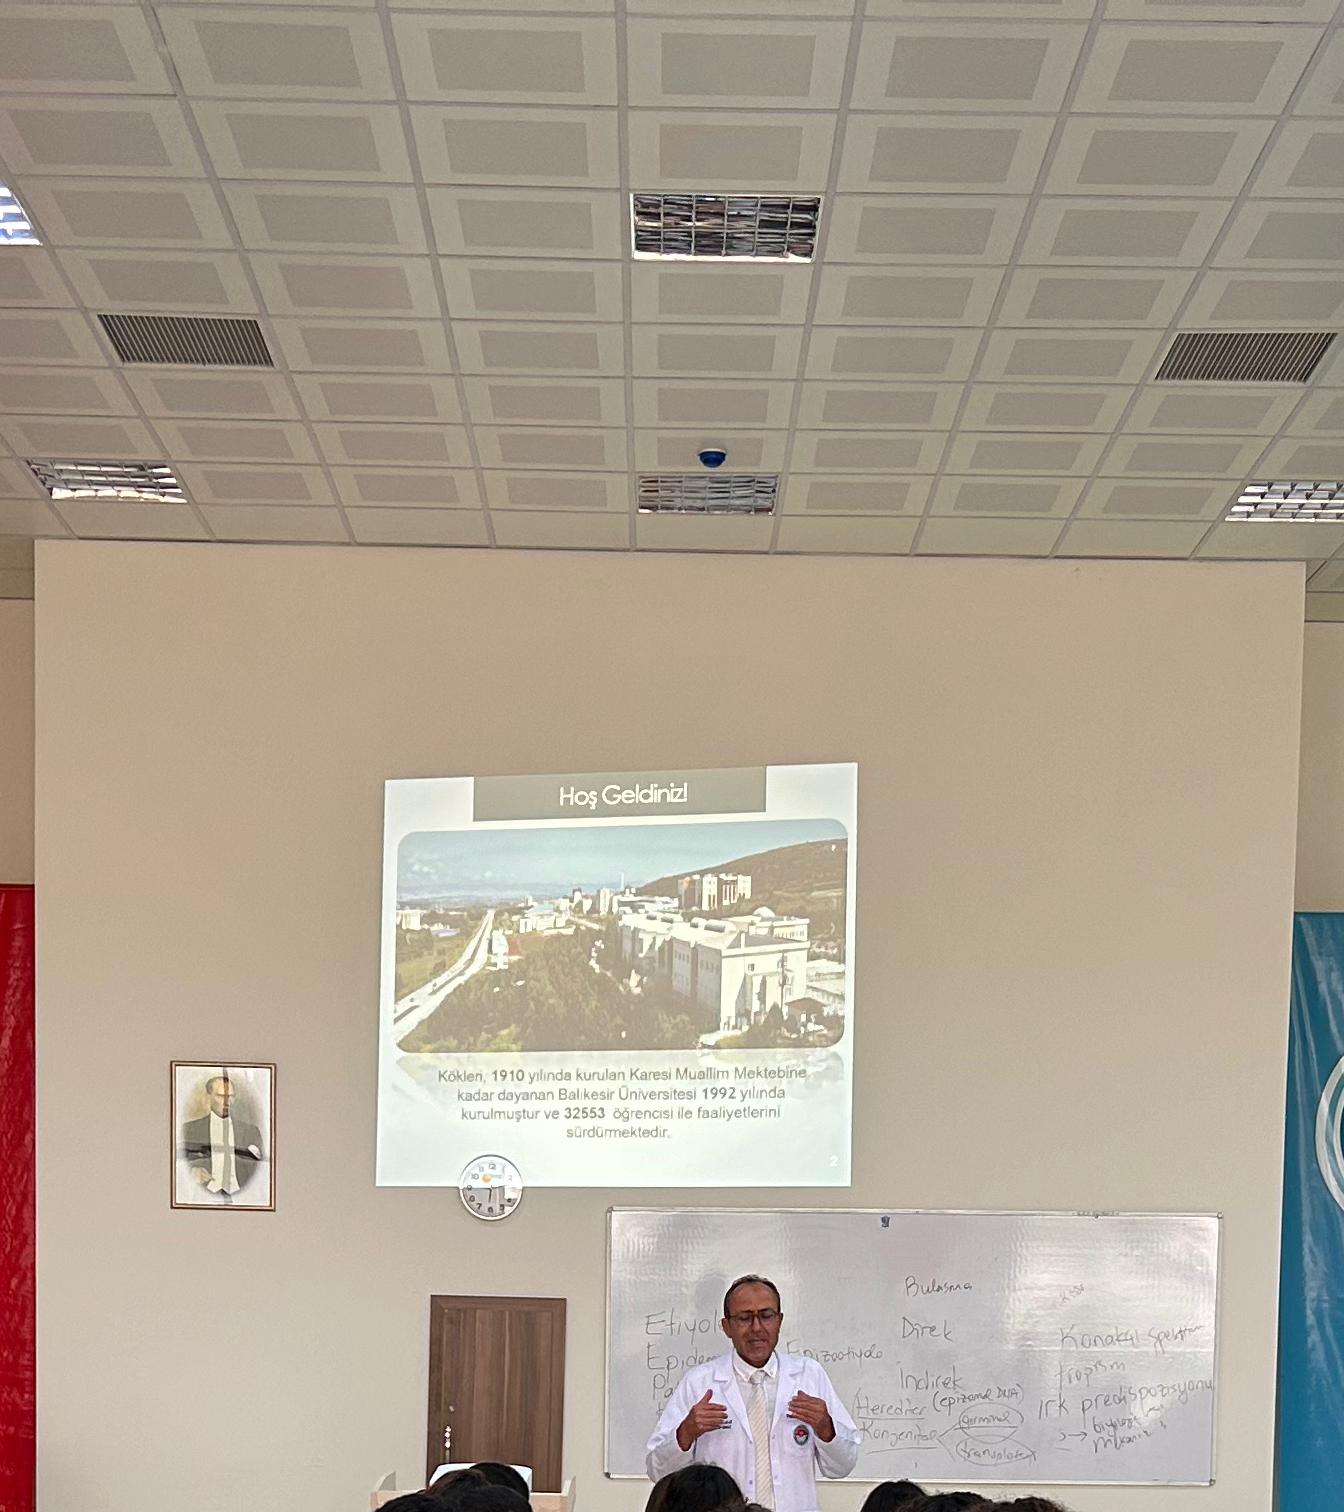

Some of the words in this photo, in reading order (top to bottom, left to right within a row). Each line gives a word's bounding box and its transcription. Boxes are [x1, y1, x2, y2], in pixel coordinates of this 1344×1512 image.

[559, 786, 598, 810] Hoş
[601, 781, 688, 806] Geldiniz!
[492, 1069, 525, 1082] 1910
[529, 1068, 572, 1085] yılında
[576, 1068, 626, 1081] kurulan
[629, 1067, 672, 1081] Karesi
[675, 1067, 730, 1081] Muallim
[457, 1089, 495, 1102] kadar
[497, 1088, 555, 1104] dayanan
[558, 1088, 615, 1101] Balıkesir
[618, 1085, 697, 1101] Üniversitesi
[702, 1087, 737, 1100] 1992
[740, 1086, 786, 1103] yılında
[461, 1108, 541, 1123] kurulmuştur
[544, 1110, 560, 1120] ve
[564, 1107, 606, 1119] 32553
[612, 1107, 674, 1123] öğrencisi
[677, 1107, 693, 1119] ile
[697, 1106, 781, 1122] faaliyetlerini
[566, 1126, 671, 1139] sürdürmektedir.
[830, 1155, 839, 1167] 2
[645, 1307, 722, 1345] Etiyol
[901, 1316, 954, 1343] Direk
